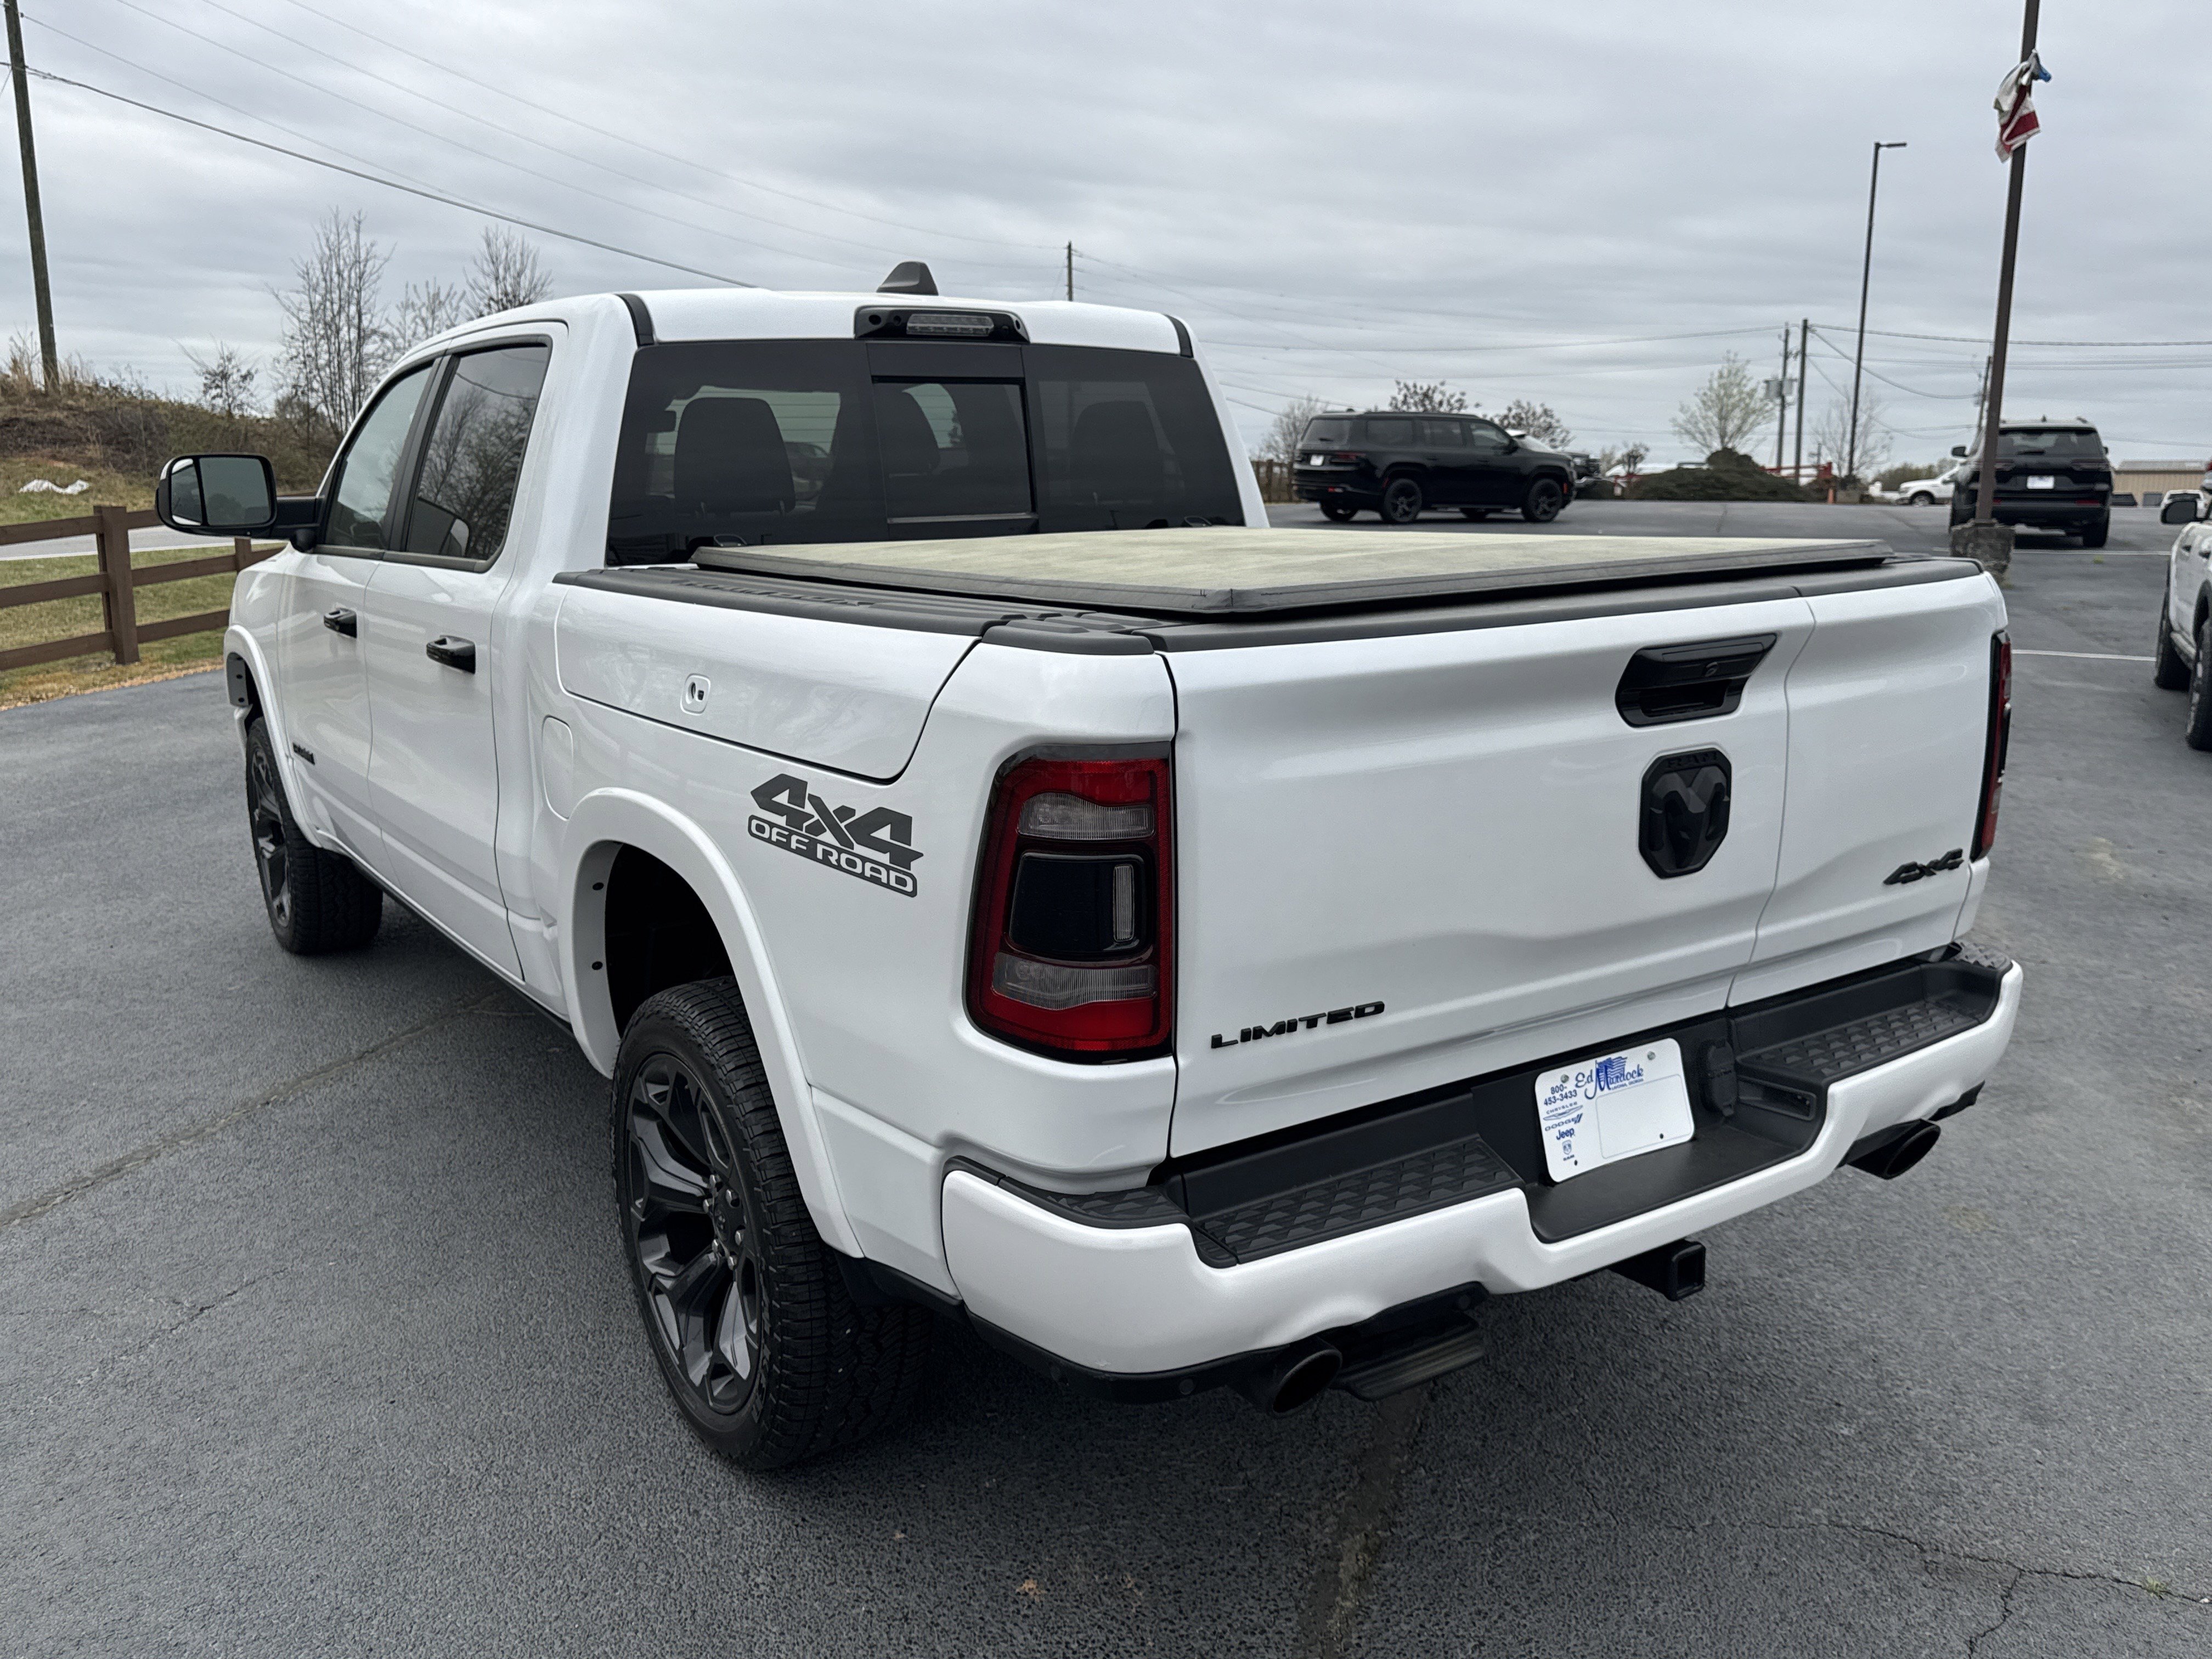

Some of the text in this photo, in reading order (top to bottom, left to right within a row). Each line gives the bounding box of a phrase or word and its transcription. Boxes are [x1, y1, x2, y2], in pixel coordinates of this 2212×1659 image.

[1667, 753, 1718, 769] RAM
[750, 819, 914, 893] OFF ROAD
[1211, 1001, 1385, 1049] LIMITED
[1575, 1069, 1594, 1088] Ed
[1556, 1128, 1575, 1141] Jeep
